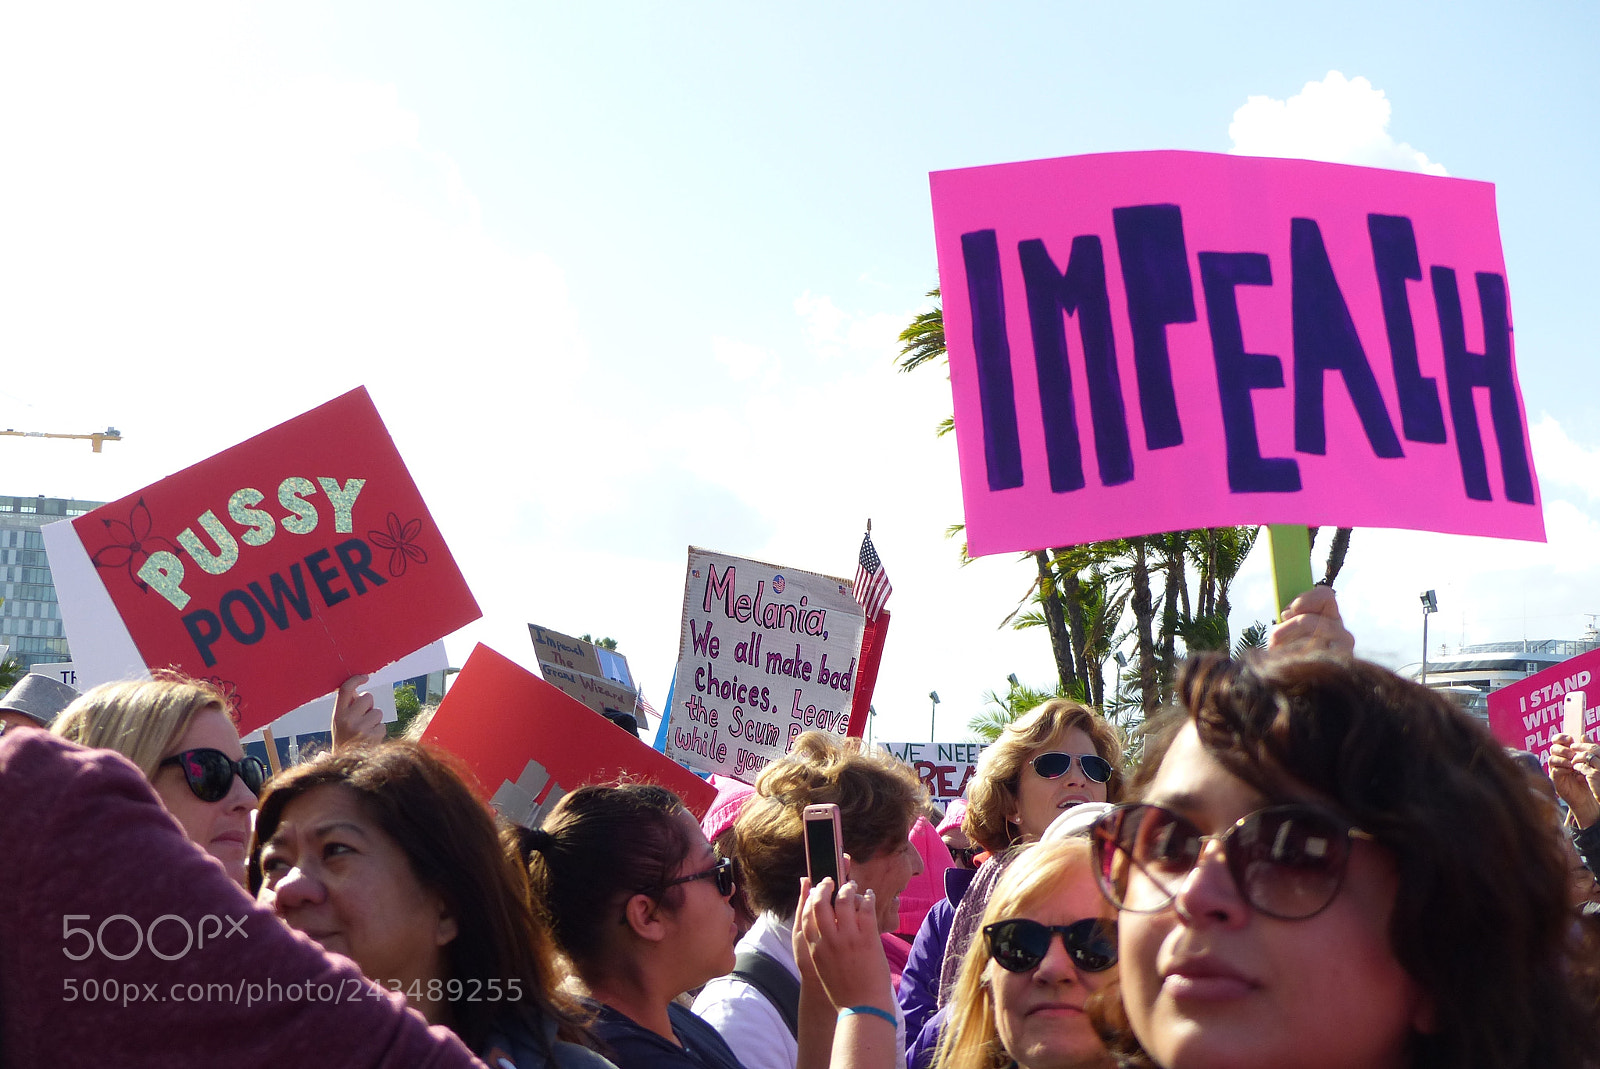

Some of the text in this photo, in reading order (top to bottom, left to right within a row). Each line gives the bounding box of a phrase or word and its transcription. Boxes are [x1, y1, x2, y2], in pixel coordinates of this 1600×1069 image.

[960, 203, 1535, 505] IMPEACH
[137, 476, 366, 611] PUSSY
[181, 537, 388, 668] POWER
[703, 563, 829, 641] Melania,
[530, 623, 584, 657] Impeach
[552, 651, 574, 669] The
[690, 618, 856, 692] We all make bad
[542, 664, 576, 684] Grand
[579, 673, 625, 704] Wizard
[1519, 670, 1592, 713] I STAND
[685, 694, 719, 728] the
[728, 705, 780, 747] Scum
[791, 688, 850, 735] Leave
[674, 725, 727, 763] while
[886, 742, 990, 763] WE NEE
